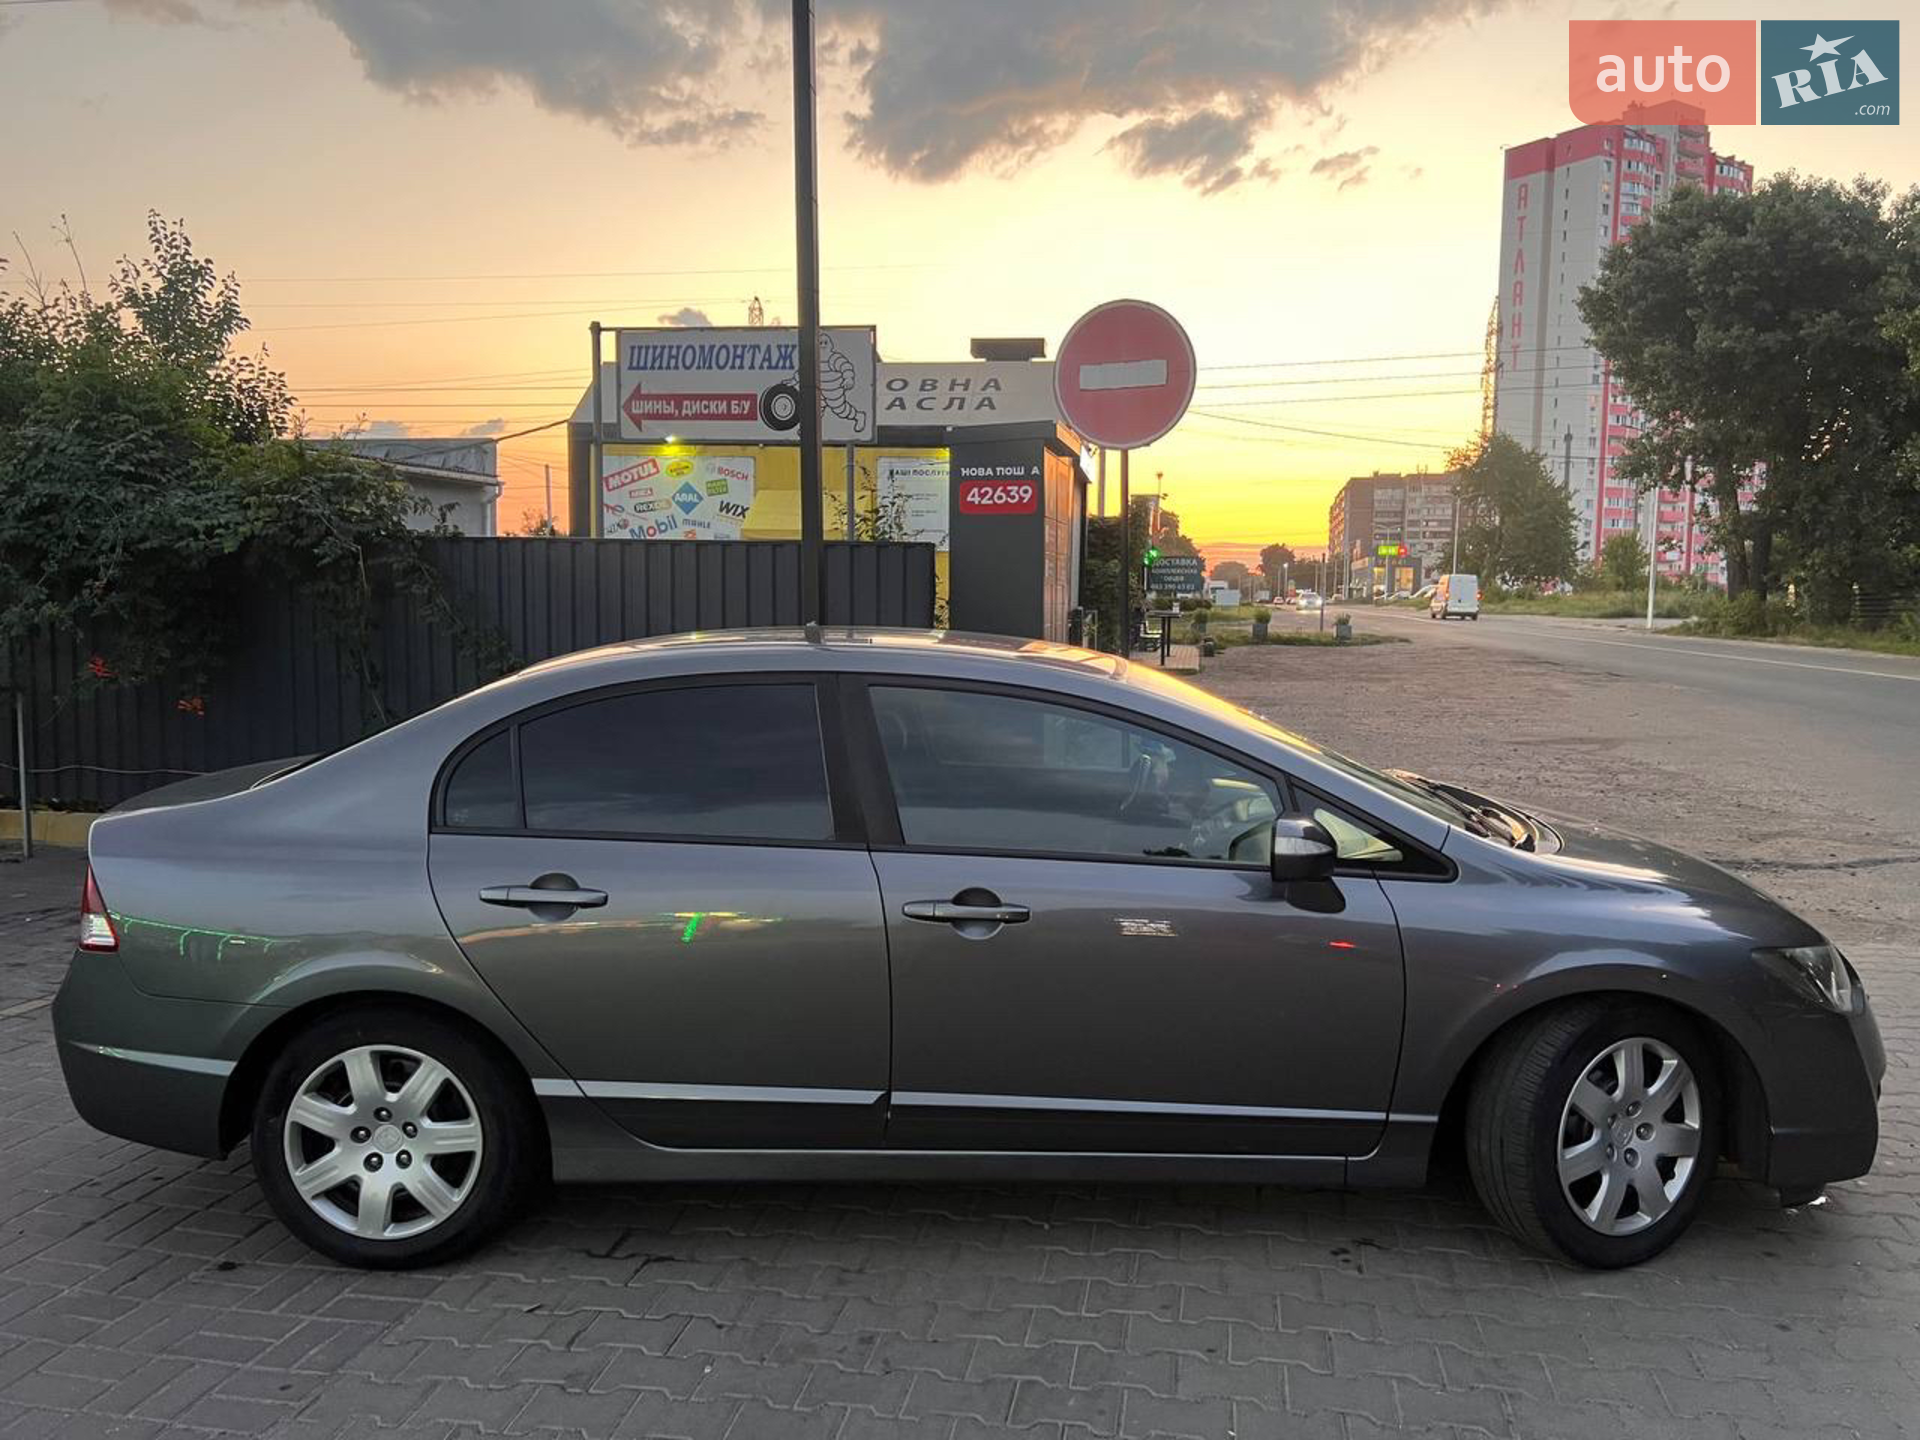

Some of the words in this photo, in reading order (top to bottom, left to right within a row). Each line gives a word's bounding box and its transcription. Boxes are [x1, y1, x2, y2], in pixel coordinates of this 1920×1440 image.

[1511, 182, 1529, 372] АТЛАНТ
[627, 344, 797, 371] ШИНОМОНТАЖ
[886, 378, 1002, 392] ОВНА
[631, 400, 679, 416] ШИНЫ,
[681, 400, 728, 417] ДИСКИ
[731, 400, 751, 416] Б/У
[885, 397, 997, 411] АСЛА
[608, 462, 659, 490] MOTUL
[718, 466, 749, 481] BOSCH
[888, 469, 912, 477] АШІ
[960, 467, 994, 477] НОВА
[674, 493, 699, 502] ARAL
[966, 485, 1033, 504] 42639
[719, 500, 750, 518] WIX
[629, 514, 678, 540] Mobil
